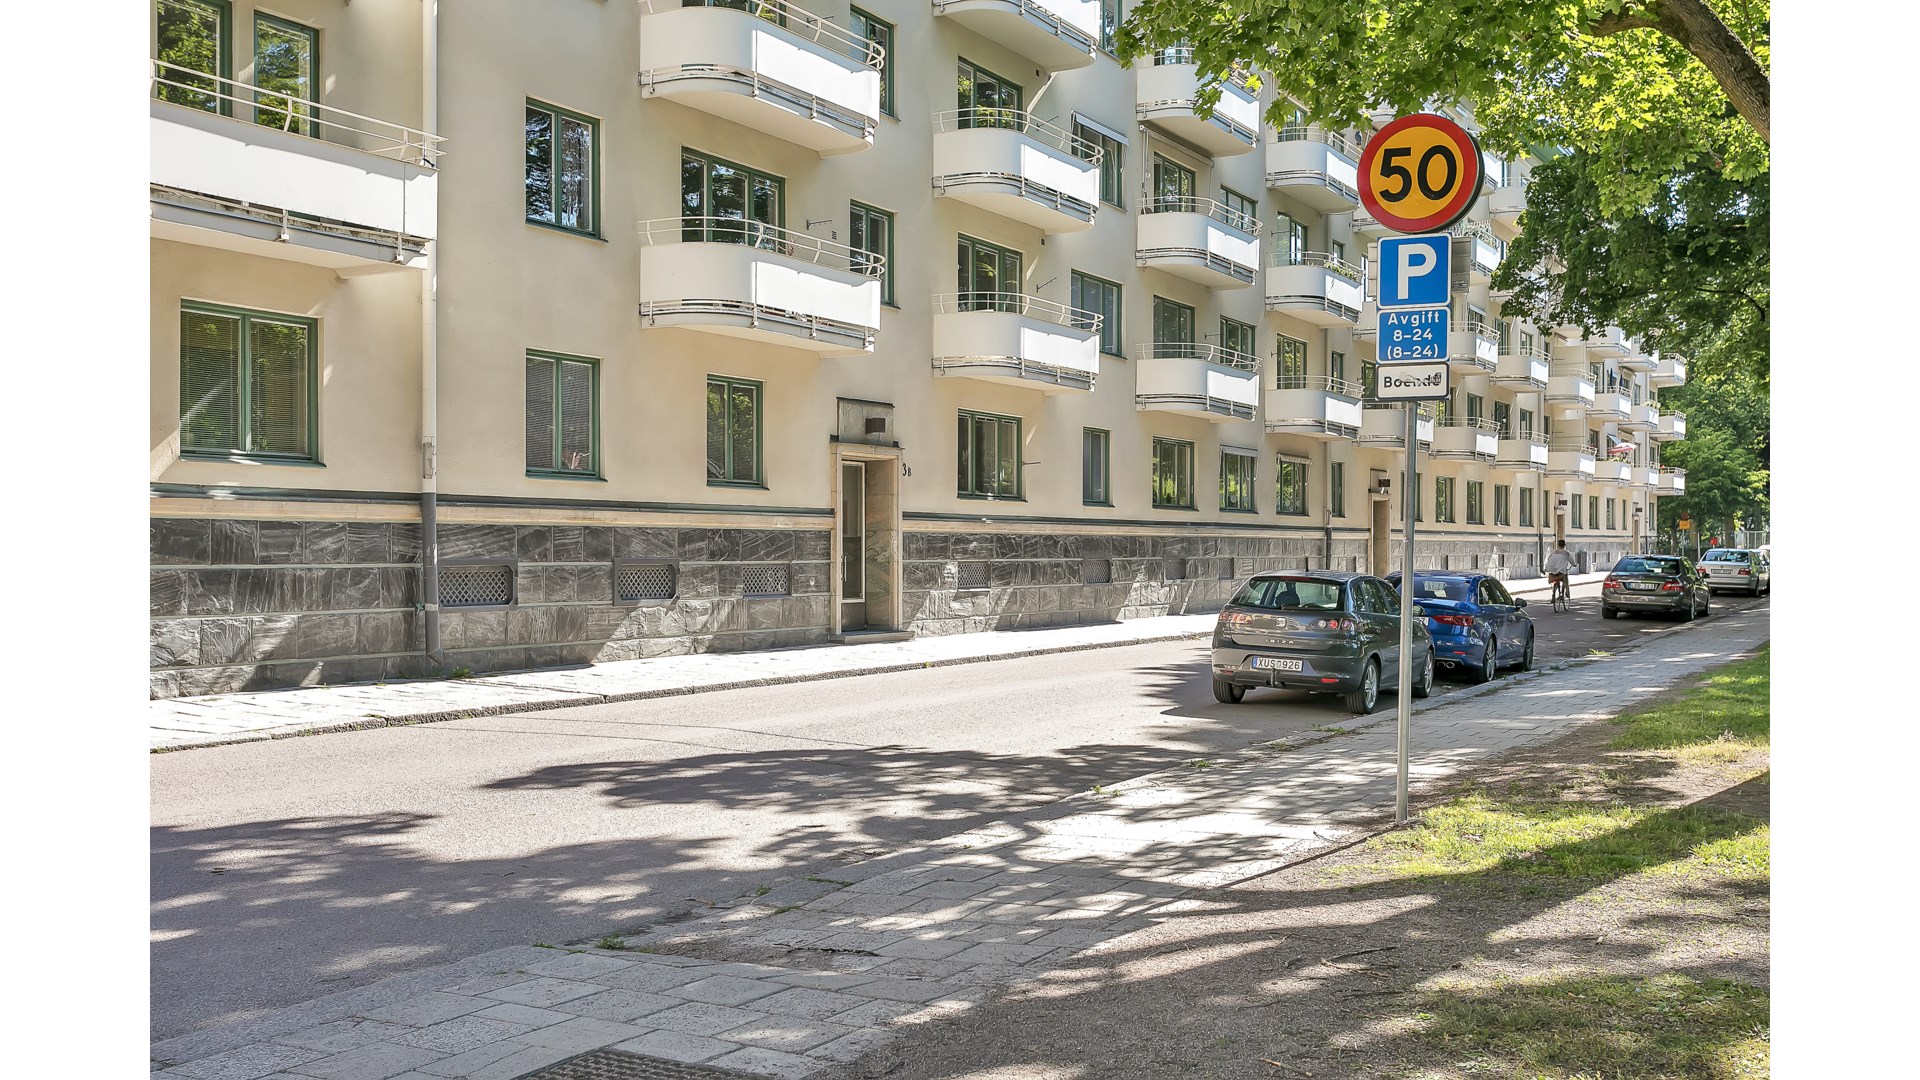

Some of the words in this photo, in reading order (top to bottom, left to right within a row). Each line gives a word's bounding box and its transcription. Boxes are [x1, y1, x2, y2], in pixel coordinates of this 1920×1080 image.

[1379, 144, 1457, 203] 50
[1397, 243, 1437, 300] P
[1388, 311, 1439, 327] Avgift
[1393, 328, 1433, 342] 8-24
[1387, 343, 1439, 360] (8-24)
